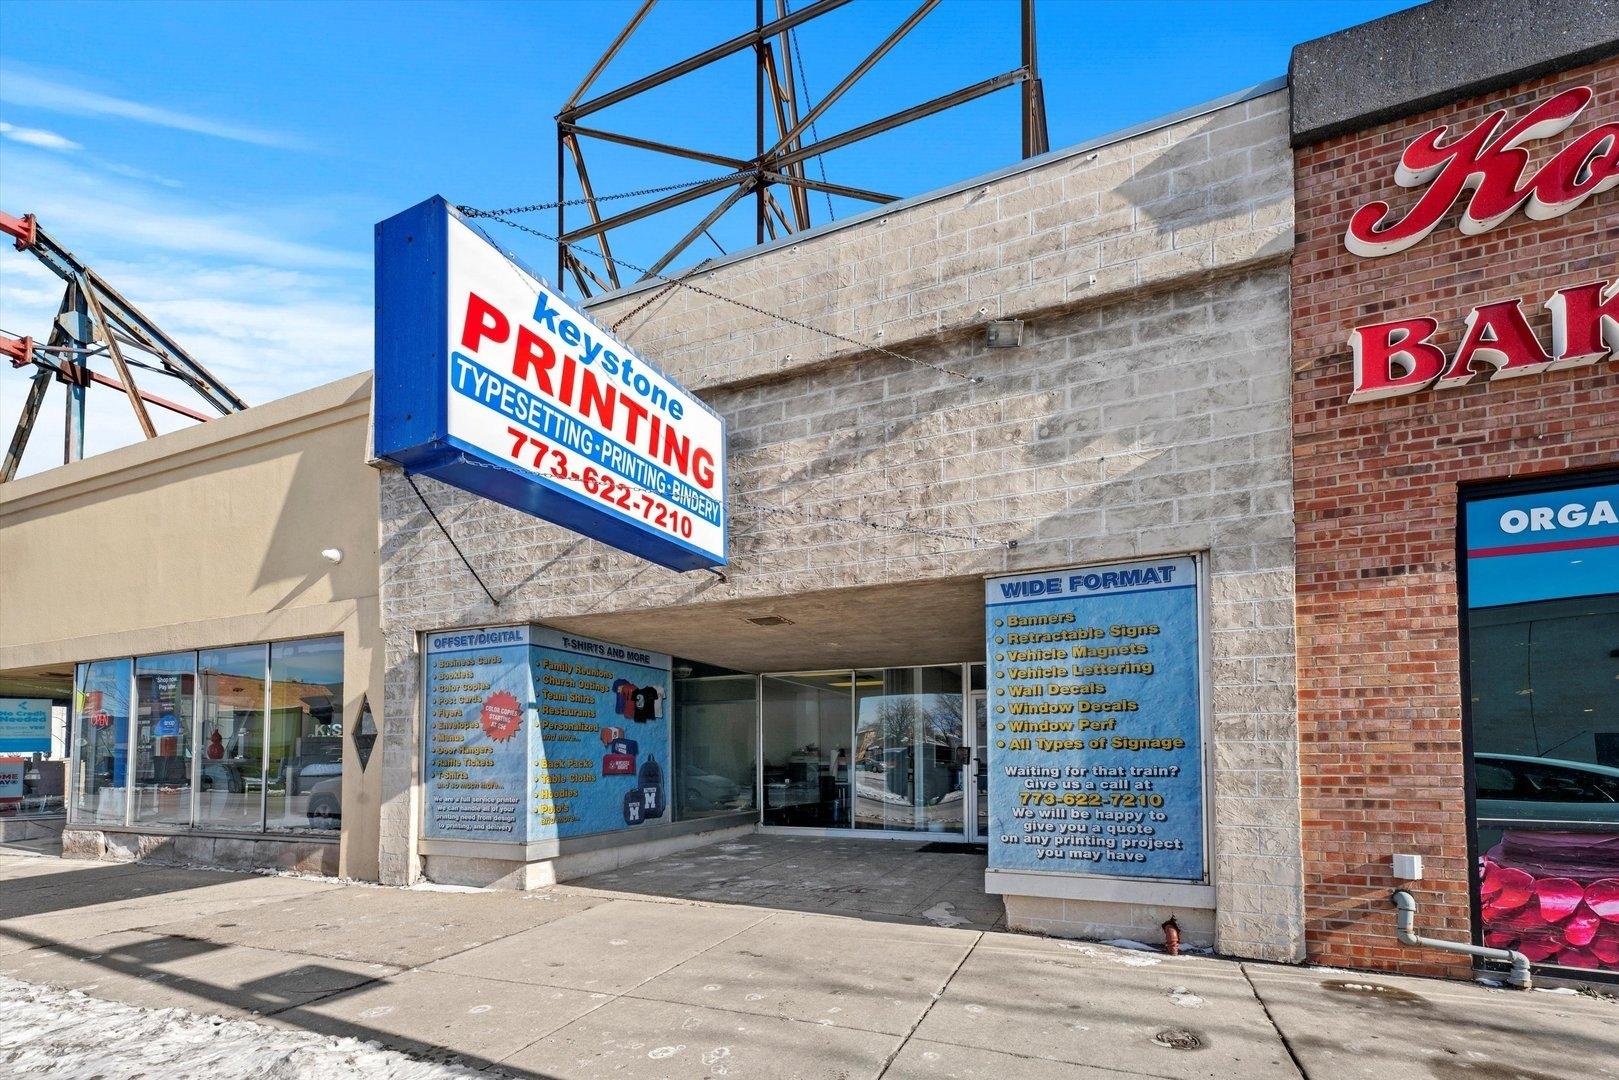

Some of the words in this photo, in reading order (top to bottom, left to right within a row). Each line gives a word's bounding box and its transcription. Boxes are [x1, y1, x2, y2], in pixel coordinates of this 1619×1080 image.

[533, 291, 684, 421] keystone
[461, 292, 714, 489] PRINTING
[507, 426, 692, 539] 773-622-7210
[1500, 501, 1619, 533] ORGA
[1000, 578, 1062, 598] WIDE
[1069, 566, 1176, 592] FORMAT
[1007, 612, 1076, 627] Banners
[434, 630, 523, 649] OFFSET/DIGITAL
[1007, 627, 1104, 645] Retractable
[1109, 623, 1160, 639] Signs
[562, 637, 605, 654] T-SHIRTS
[607, 648, 625, 659] AND
[627, 652, 651, 664] MORE
[1008, 647, 1067, 663] Vehicle
[1072, 642, 1148, 659] Magnets
[438, 658, 475, 668] Business
[477, 656, 502, 664] Cards
[542, 659, 573, 674] Family
[576, 666, 613, 679] Reunions
[437, 672, 474, 680] Booklets
[1008, 664, 1068, 680] Vehicle
[1072, 661, 1153, 677] Lettering
[437, 684, 460, 692] Color
[463, 683, 490, 691] Copies
[542, 675, 575, 687] Church
[579, 682, 609, 692] Outings
[1009, 684, 1042, 698] Wall
[1047, 681, 1106, 696] Decals
[438, 697, 456, 705] Post
[459, 695, 483, 703] Cards
[542, 689, 567, 701] Team
[569, 694, 595, 704] Shirts
[437, 709, 463, 718] Flyers
[542, 705, 596, 718] Restaurants
[1009, 701, 1074, 715] Window
[1078, 700, 1139, 713] Decals
[437, 721, 479, 730] Envelopes
[542, 721, 599, 732] Personalized
[1009, 719, 1074, 733] Window
[1078, 718, 1116, 732] Perf
[437, 747, 457, 755] Door
[460, 746, 493, 755] Hangers
[1009, 738, 1031, 751] All
[1036, 738, 1084, 753] Types
[1089, 737, 1107, 749] of
[1111, 736, 1185, 750] Signage
[464, 758, 495, 767] Tickets
[541, 760, 565, 769] Back
[567, 759, 593, 768] Packs
[541, 775, 566, 784] Table
[570, 774, 596, 782] Cloths
[1005, 766, 1061, 779] Waiting
[1065, 766, 1089, 777] for
[1092, 766, 1126, 777] that
[1130, 765, 1181, 777] train?
[1024, 778, 1058, 790] Give
[1062, 781, 1080, 790] us
[1085, 781, 1095, 790] a
[1100, 778, 1130, 790] call
[1134, 780, 1153, 791] at
[541, 789, 578, 798] Hoodies
[1018, 792, 1165, 808] 773-622-7210
[541, 805, 569, 814] Polo's
[1012, 808, 1035, 819] We
[1038, 808, 1067, 820] will
[1070, 808, 1091, 820] be
[1095, 809, 1143, 823] happy
[1149, 811, 1167, 823] to
[1023, 822, 1055, 834] give
[1059, 824, 1087, 835] you
[1091, 824, 1102, 834] a
[1106, 824, 1155, 836] quote
[1000, 834, 1019, 844] on
[1023, 834, 1050, 846] any
[1054, 835, 1116, 849] printing
[1121, 837, 1183, 850] project
[1036, 849, 1064, 861] you
[1069, 850, 1102, 862] may
[1106, 851, 1146, 862] have
